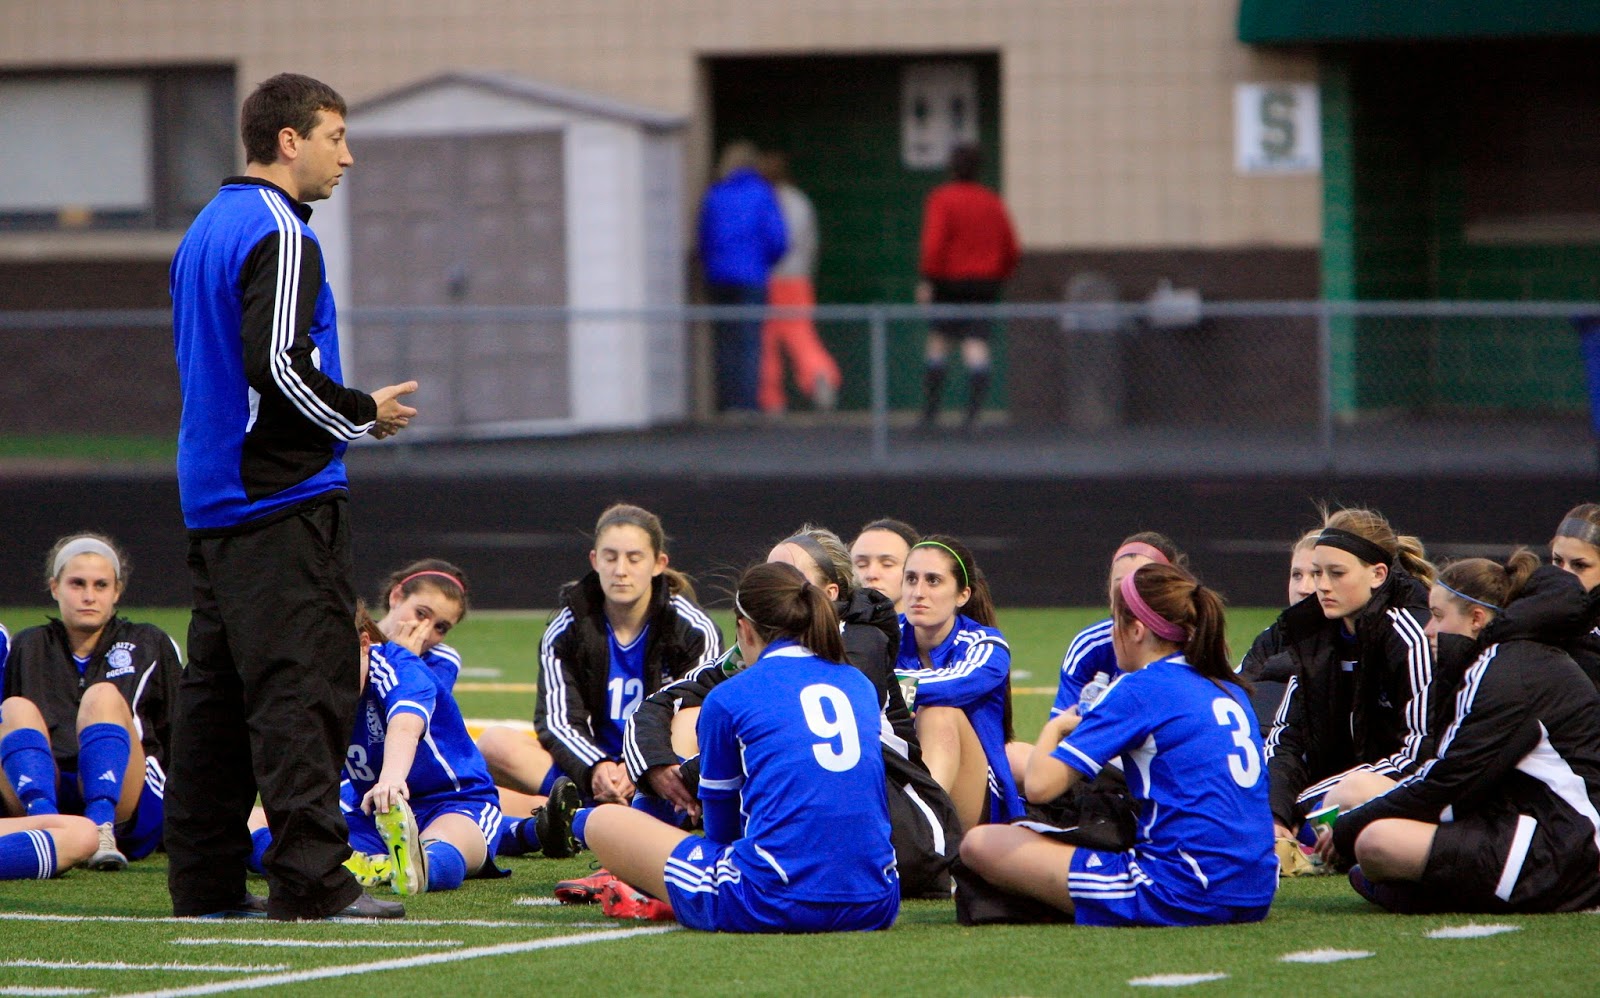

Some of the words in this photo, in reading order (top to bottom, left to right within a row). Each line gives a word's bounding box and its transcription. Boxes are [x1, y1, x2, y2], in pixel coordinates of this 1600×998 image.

[1260, 86, 1297, 158] S
[106, 665, 135, 679] SOCCER
[608, 676, 644, 720] 12
[799, 682, 861, 773] 9
[1212, 697, 1261, 789] 3
